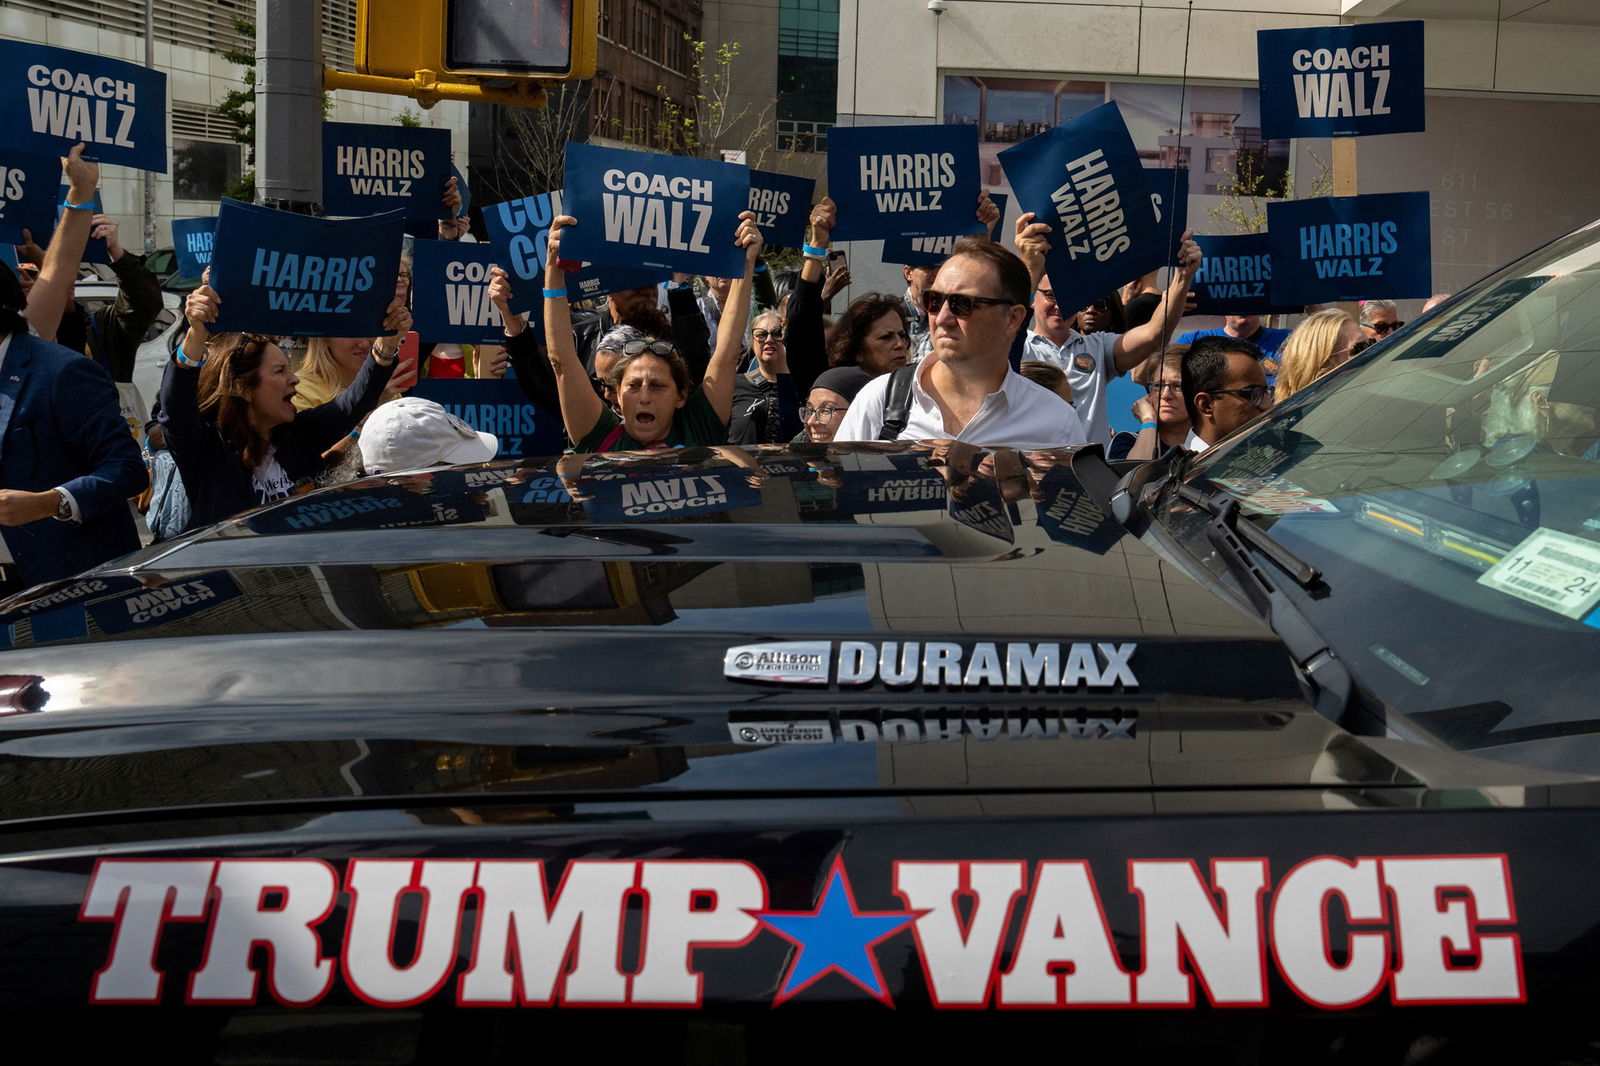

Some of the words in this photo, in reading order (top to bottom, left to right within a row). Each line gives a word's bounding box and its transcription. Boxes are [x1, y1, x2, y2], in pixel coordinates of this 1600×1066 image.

[1292, 45, 1390, 71] COACH
[28, 64, 135, 103] COACH
[1292, 69, 1391, 119] WALZ
[27, 87, 135, 148] WALZ
[337, 145, 425, 179] HARRIS
[860, 152, 956, 191] HARRIS
[350, 178, 412, 197] WALZ
[603, 168, 712, 202] COACH
[1441, 172, 1479, 191] 611
[748, 187, 791, 215] RRIS
[875, 191, 942, 213] WALZ
[1066, 149, 1131, 261] HARRIS
[1431, 201, 1472, 219] EST
[1485, 202, 1514, 220] 56
[603, 193, 713, 254] WALZ
[756, 212, 777, 228] LZ
[1050, 182, 1091, 261] WALZ
[186, 232, 216, 253] HAR
[1300, 220, 1398, 260] HARRIS
[251, 248, 376, 292] HARRIS
[1195, 254, 1271, 283] HARRIS
[1315, 257, 1383, 280] WALZ
[268, 290, 354, 314] WALZ
[1208, 282, 1265, 299] WALZ
[498, 438, 523, 456] LZ
[1508, 556, 1533, 574] 11
[1564, 576, 1599, 597] 24
[757, 652, 820, 664] Allison
[837, 640, 1139, 687] DURAMAX
[78, 857, 770, 1008] TRUMP
[893, 853, 1527, 1009] VANCE
